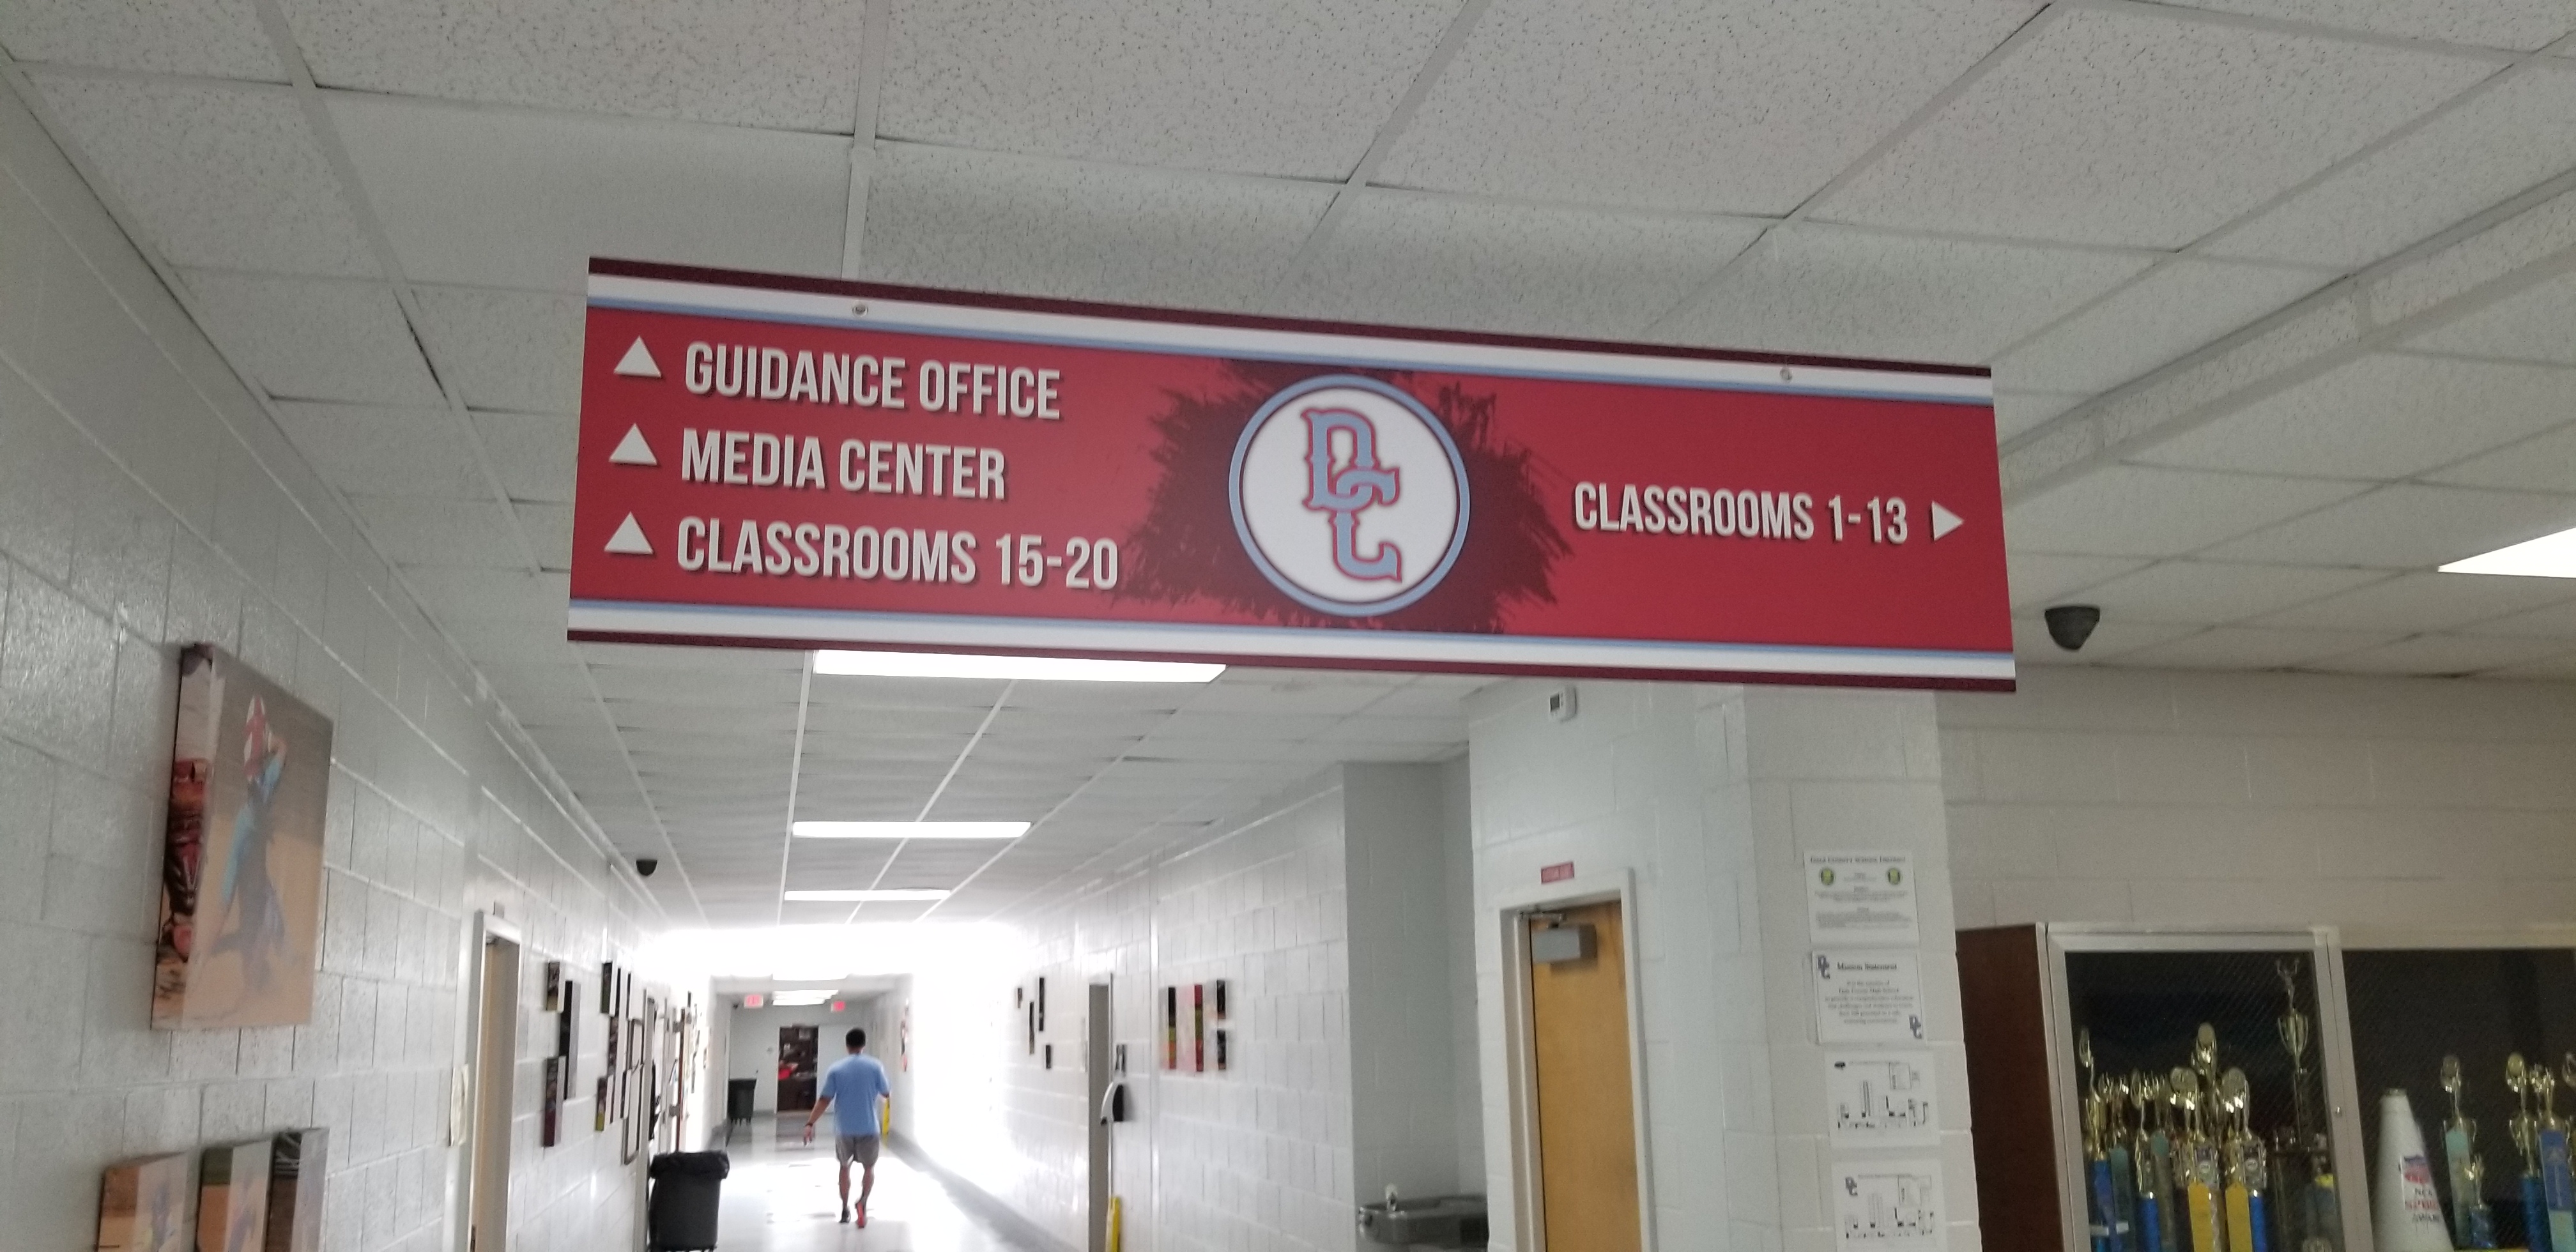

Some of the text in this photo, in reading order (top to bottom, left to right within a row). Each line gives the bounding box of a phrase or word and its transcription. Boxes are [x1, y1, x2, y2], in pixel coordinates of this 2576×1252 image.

[686, 344, 1059, 418] GUIDANCE OFFICE
[682, 429, 1004, 498] MEDIA CENTER
[1575, 483, 1907, 542] CLASSROOMS 1-13
[678, 517, 1117, 589] CLASSROOMS 15-20
